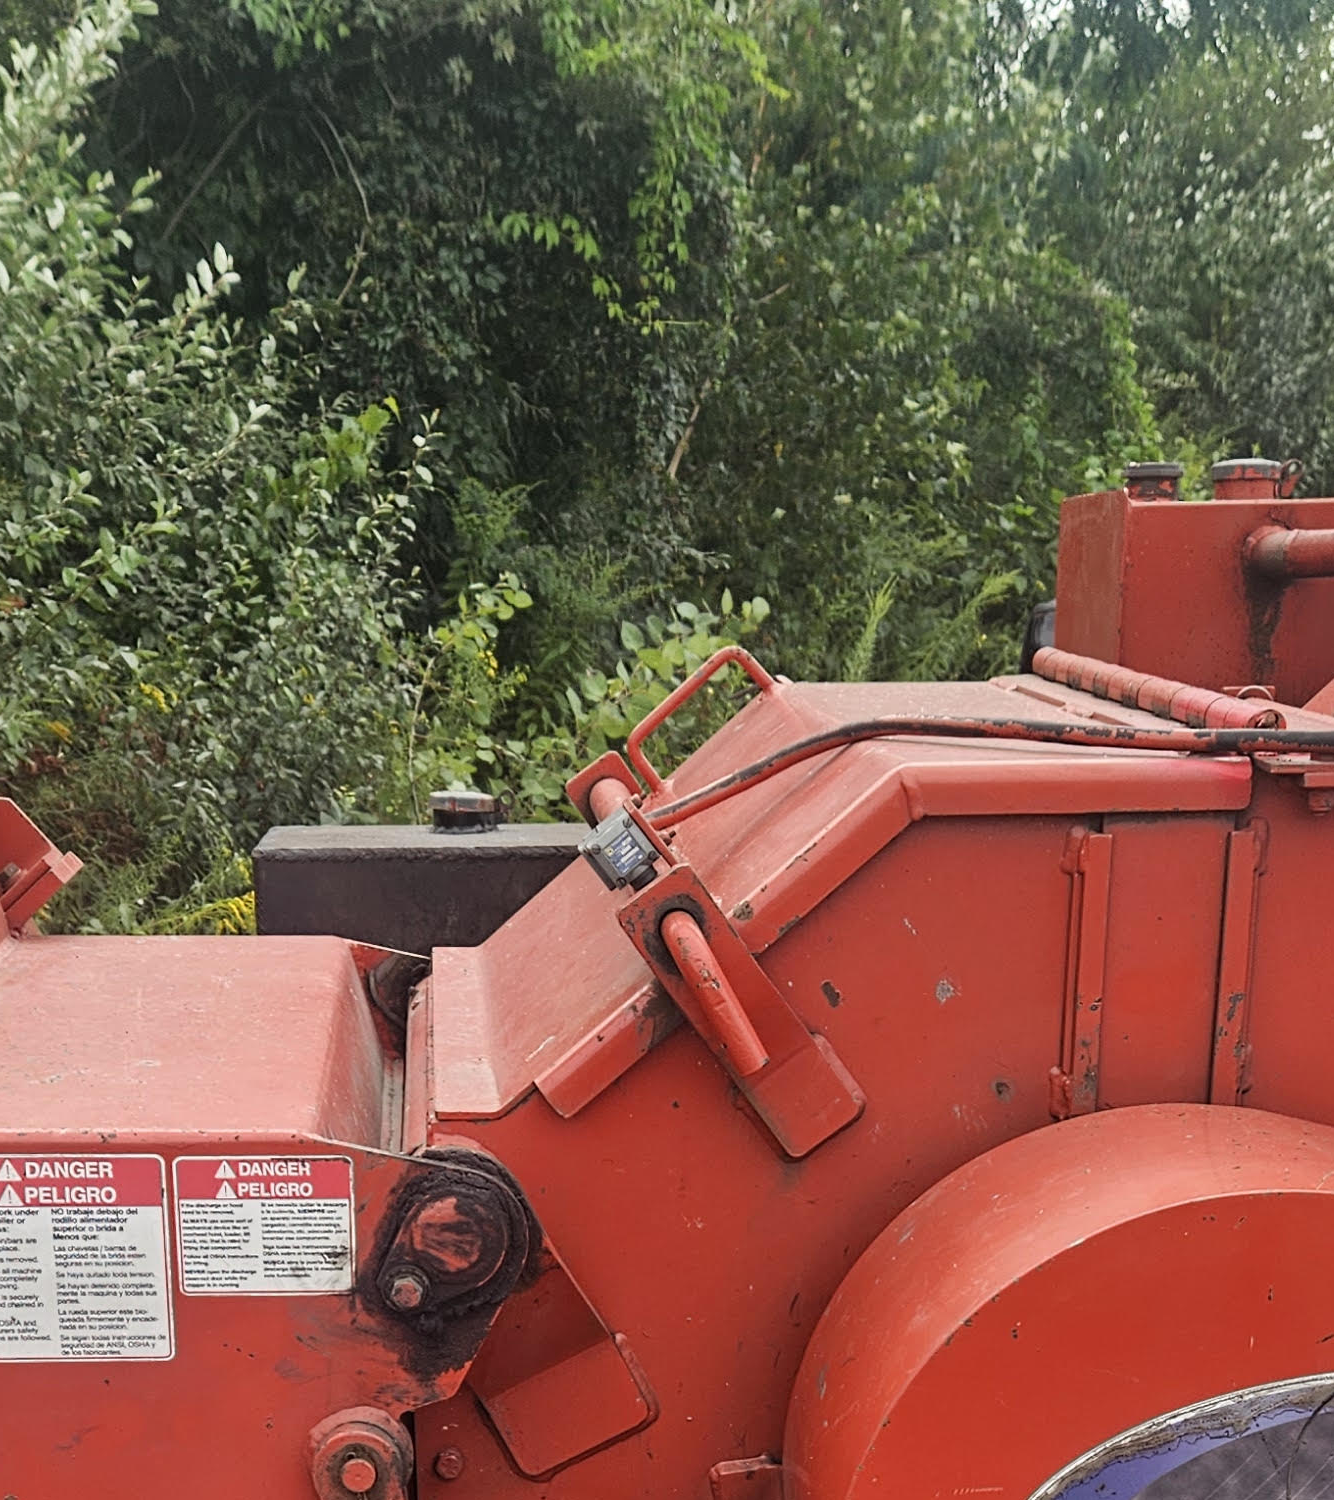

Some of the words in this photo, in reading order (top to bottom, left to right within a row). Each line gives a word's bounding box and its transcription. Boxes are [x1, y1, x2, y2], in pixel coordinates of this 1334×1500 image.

[24, 1161, 113, 1178] DANGER
[237, 1161, 311, 1176] DANGER
[23, 1186, 117, 1204] PELIGRO
[237, 1182, 313, 1196] PELIGRO
[65, 1208, 94, 1216] trabaje
[95, 1207, 124, 1216] debajo
[125, 1207, 138, 1215] del
[51, 1224, 86, 1233] superior
